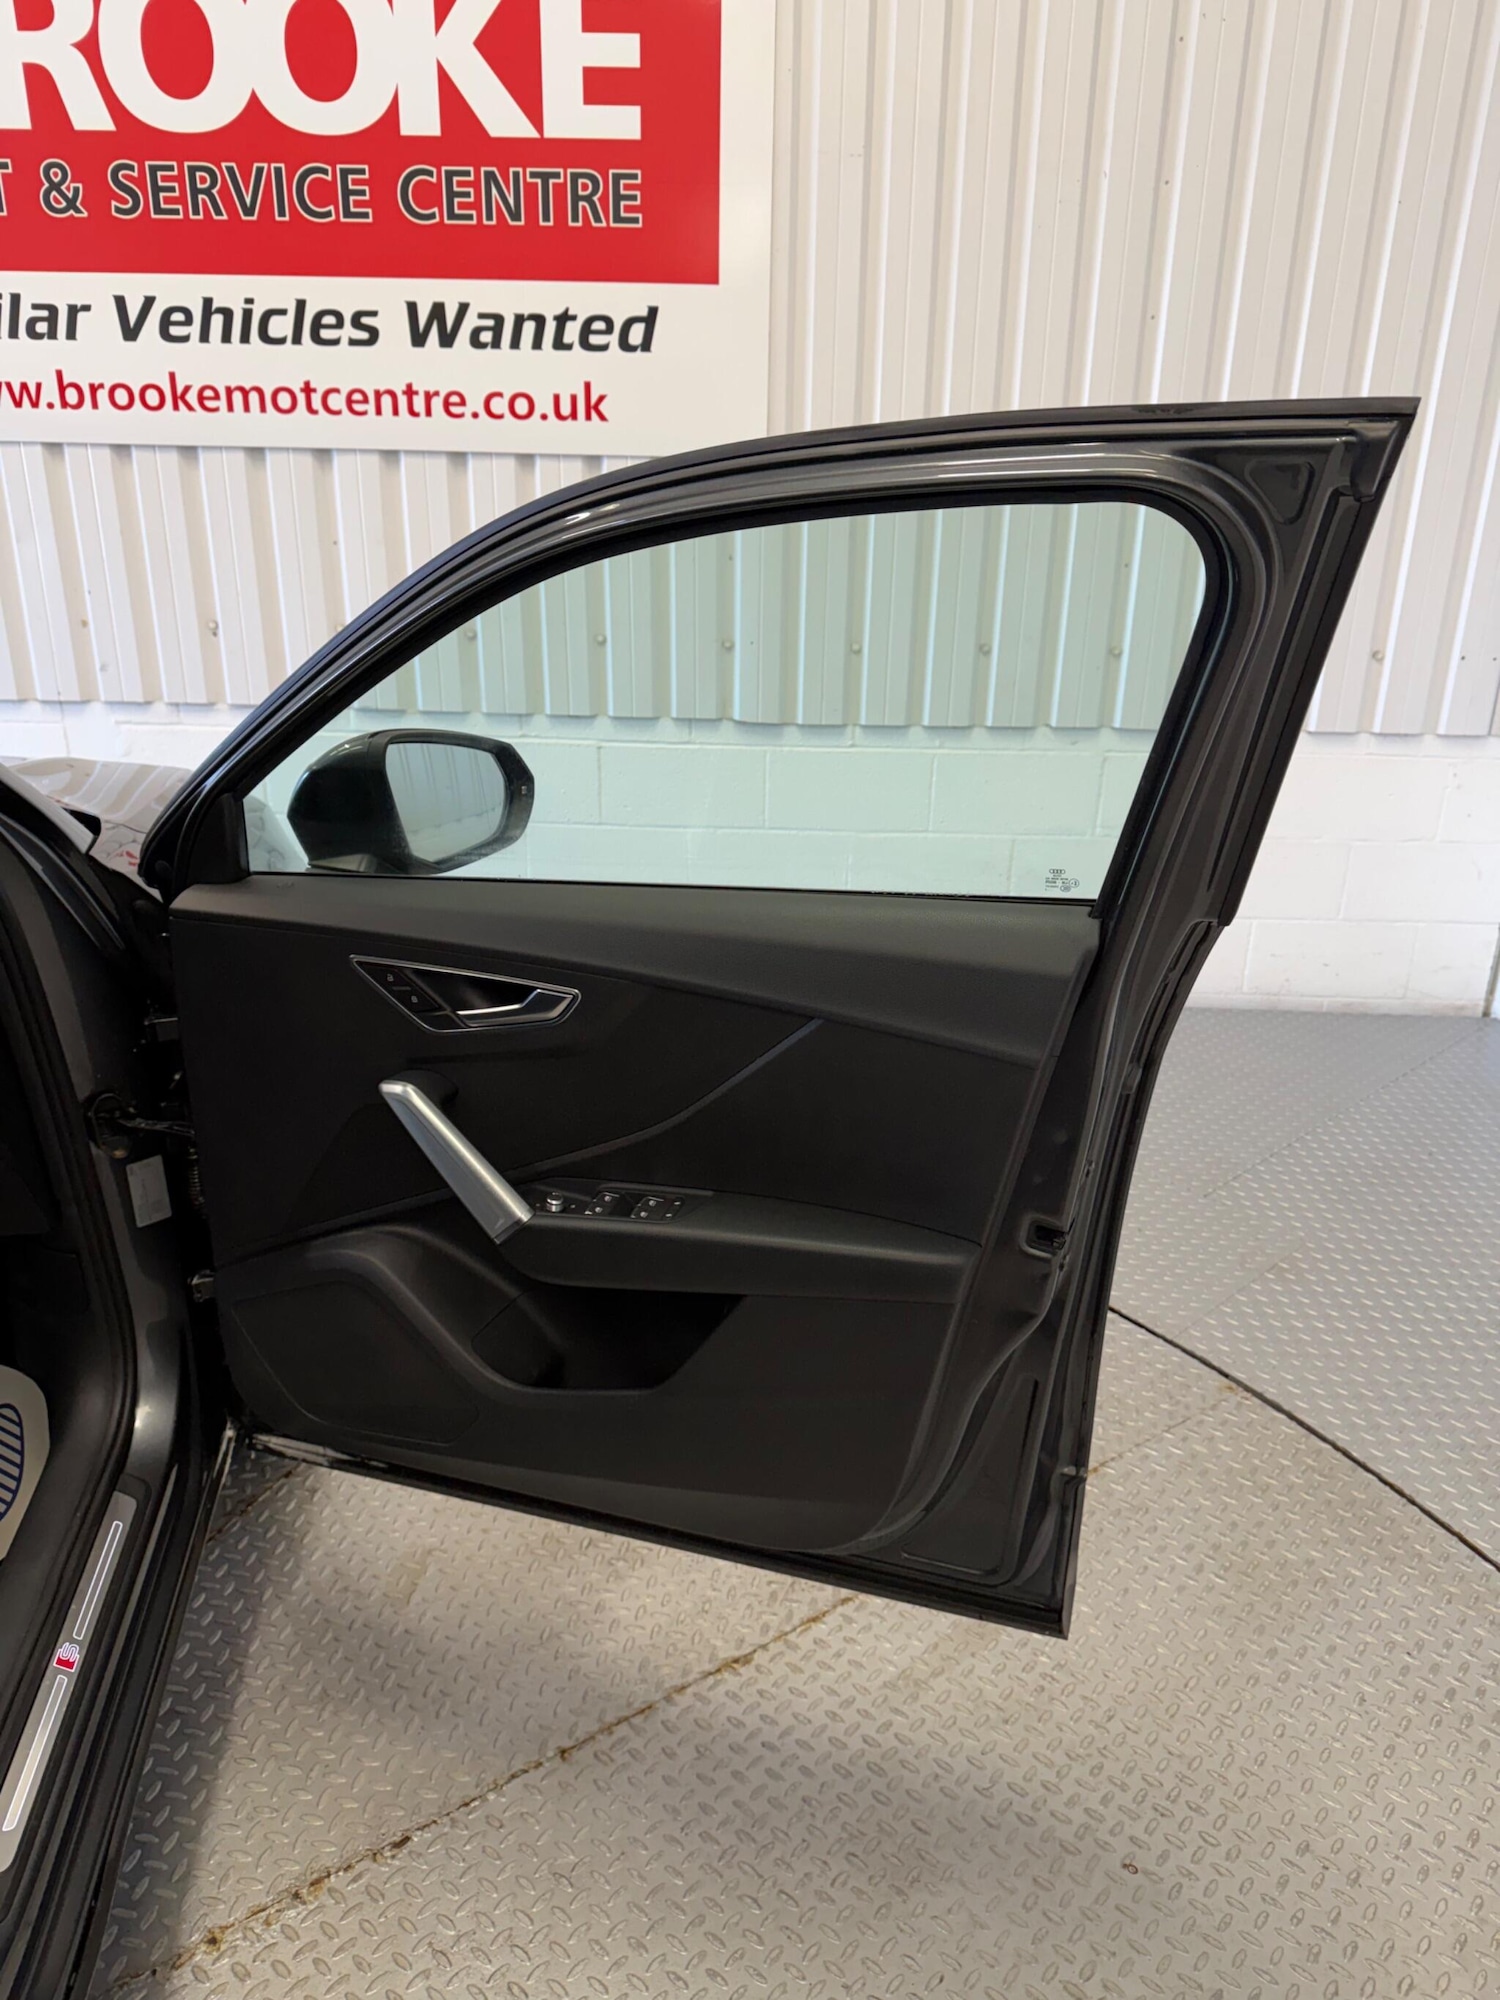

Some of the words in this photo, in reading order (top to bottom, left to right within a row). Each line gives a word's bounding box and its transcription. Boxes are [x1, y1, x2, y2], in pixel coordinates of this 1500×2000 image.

[40, 158, 88, 218] &
[107, 160, 373, 222] SERVICE
[397, 165, 642, 228] CENTRE
[0, 292, 91, 341] lar
[112, 294, 380, 347] Vehicles
[405, 300, 659, 353] Wanted
[0, 369, 609, 422] w.brookemotcentre.co.uk
